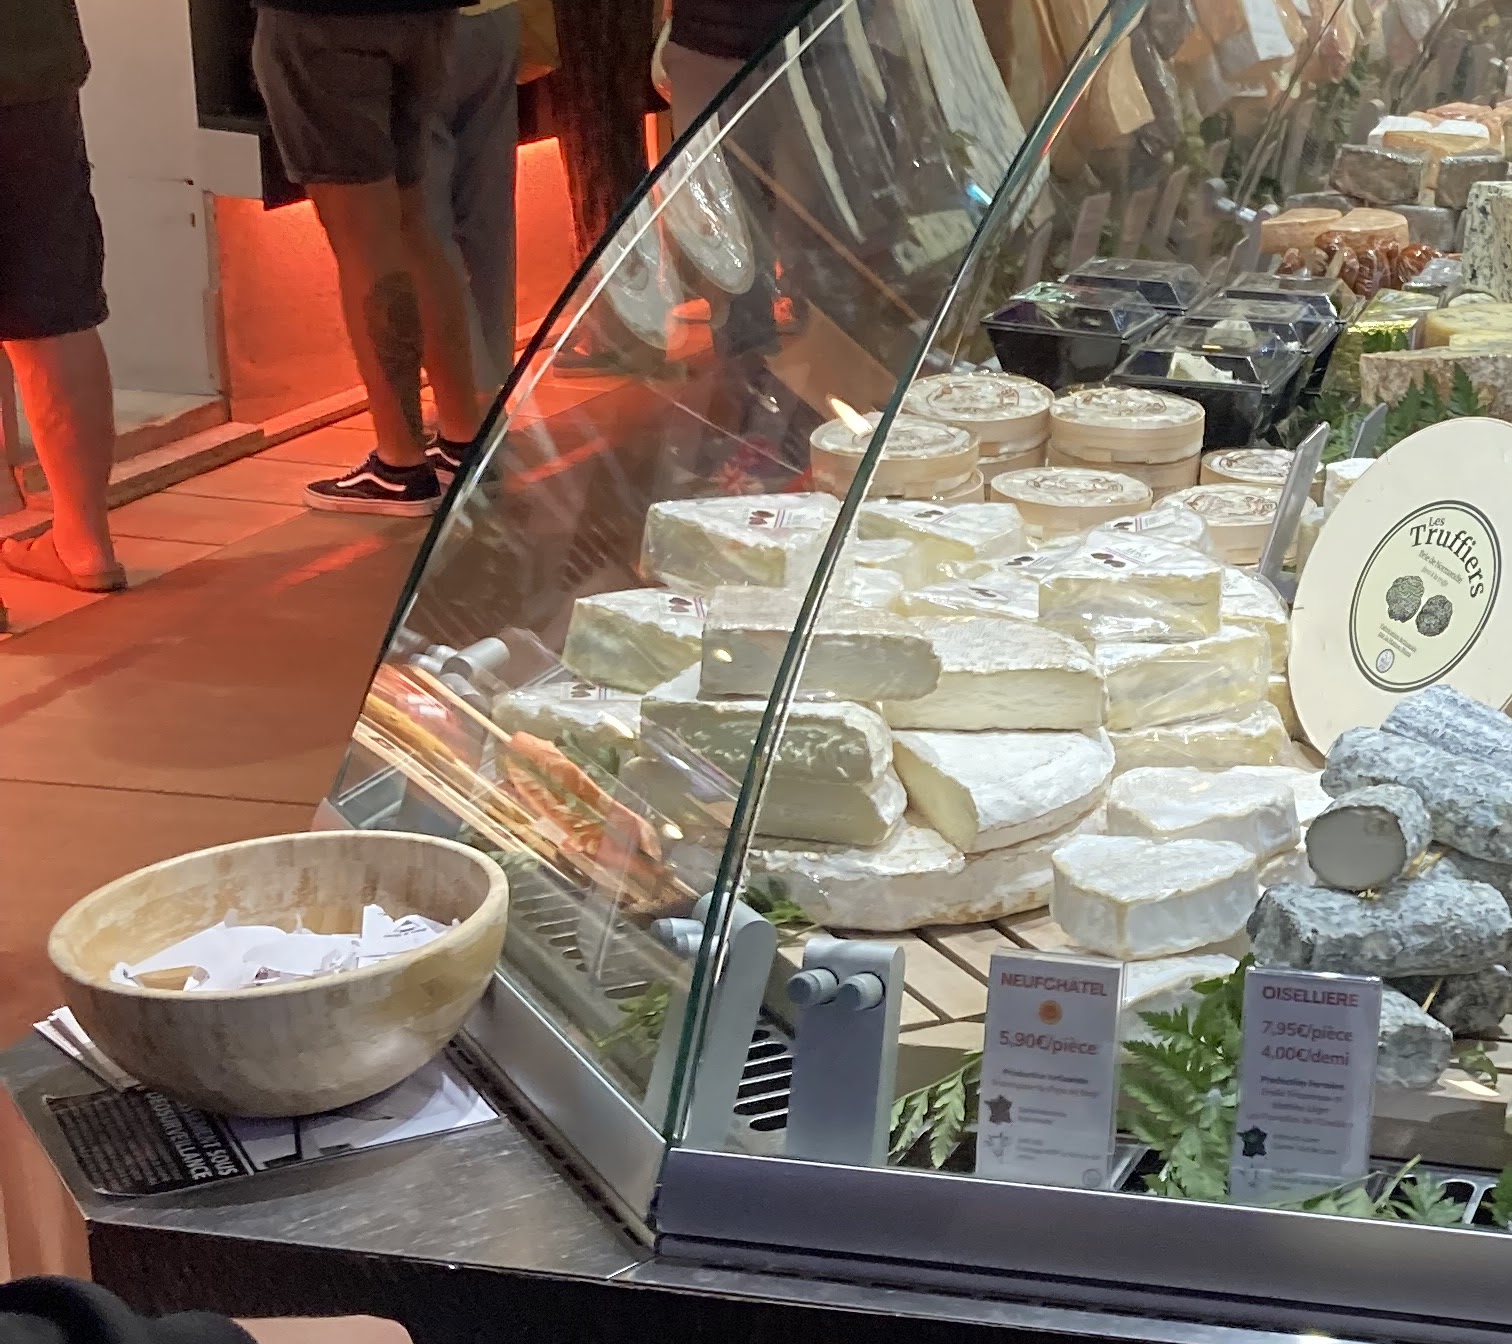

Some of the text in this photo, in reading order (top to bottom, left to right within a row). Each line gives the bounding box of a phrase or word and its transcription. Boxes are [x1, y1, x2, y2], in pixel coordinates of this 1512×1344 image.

[1428, 516, 1446, 527] Les
[1409, 523, 1485, 599] Truffiers
[1262, 986, 1360, 1008] OISELLIERE
[206, 1147, 239, 1177] SOUS
